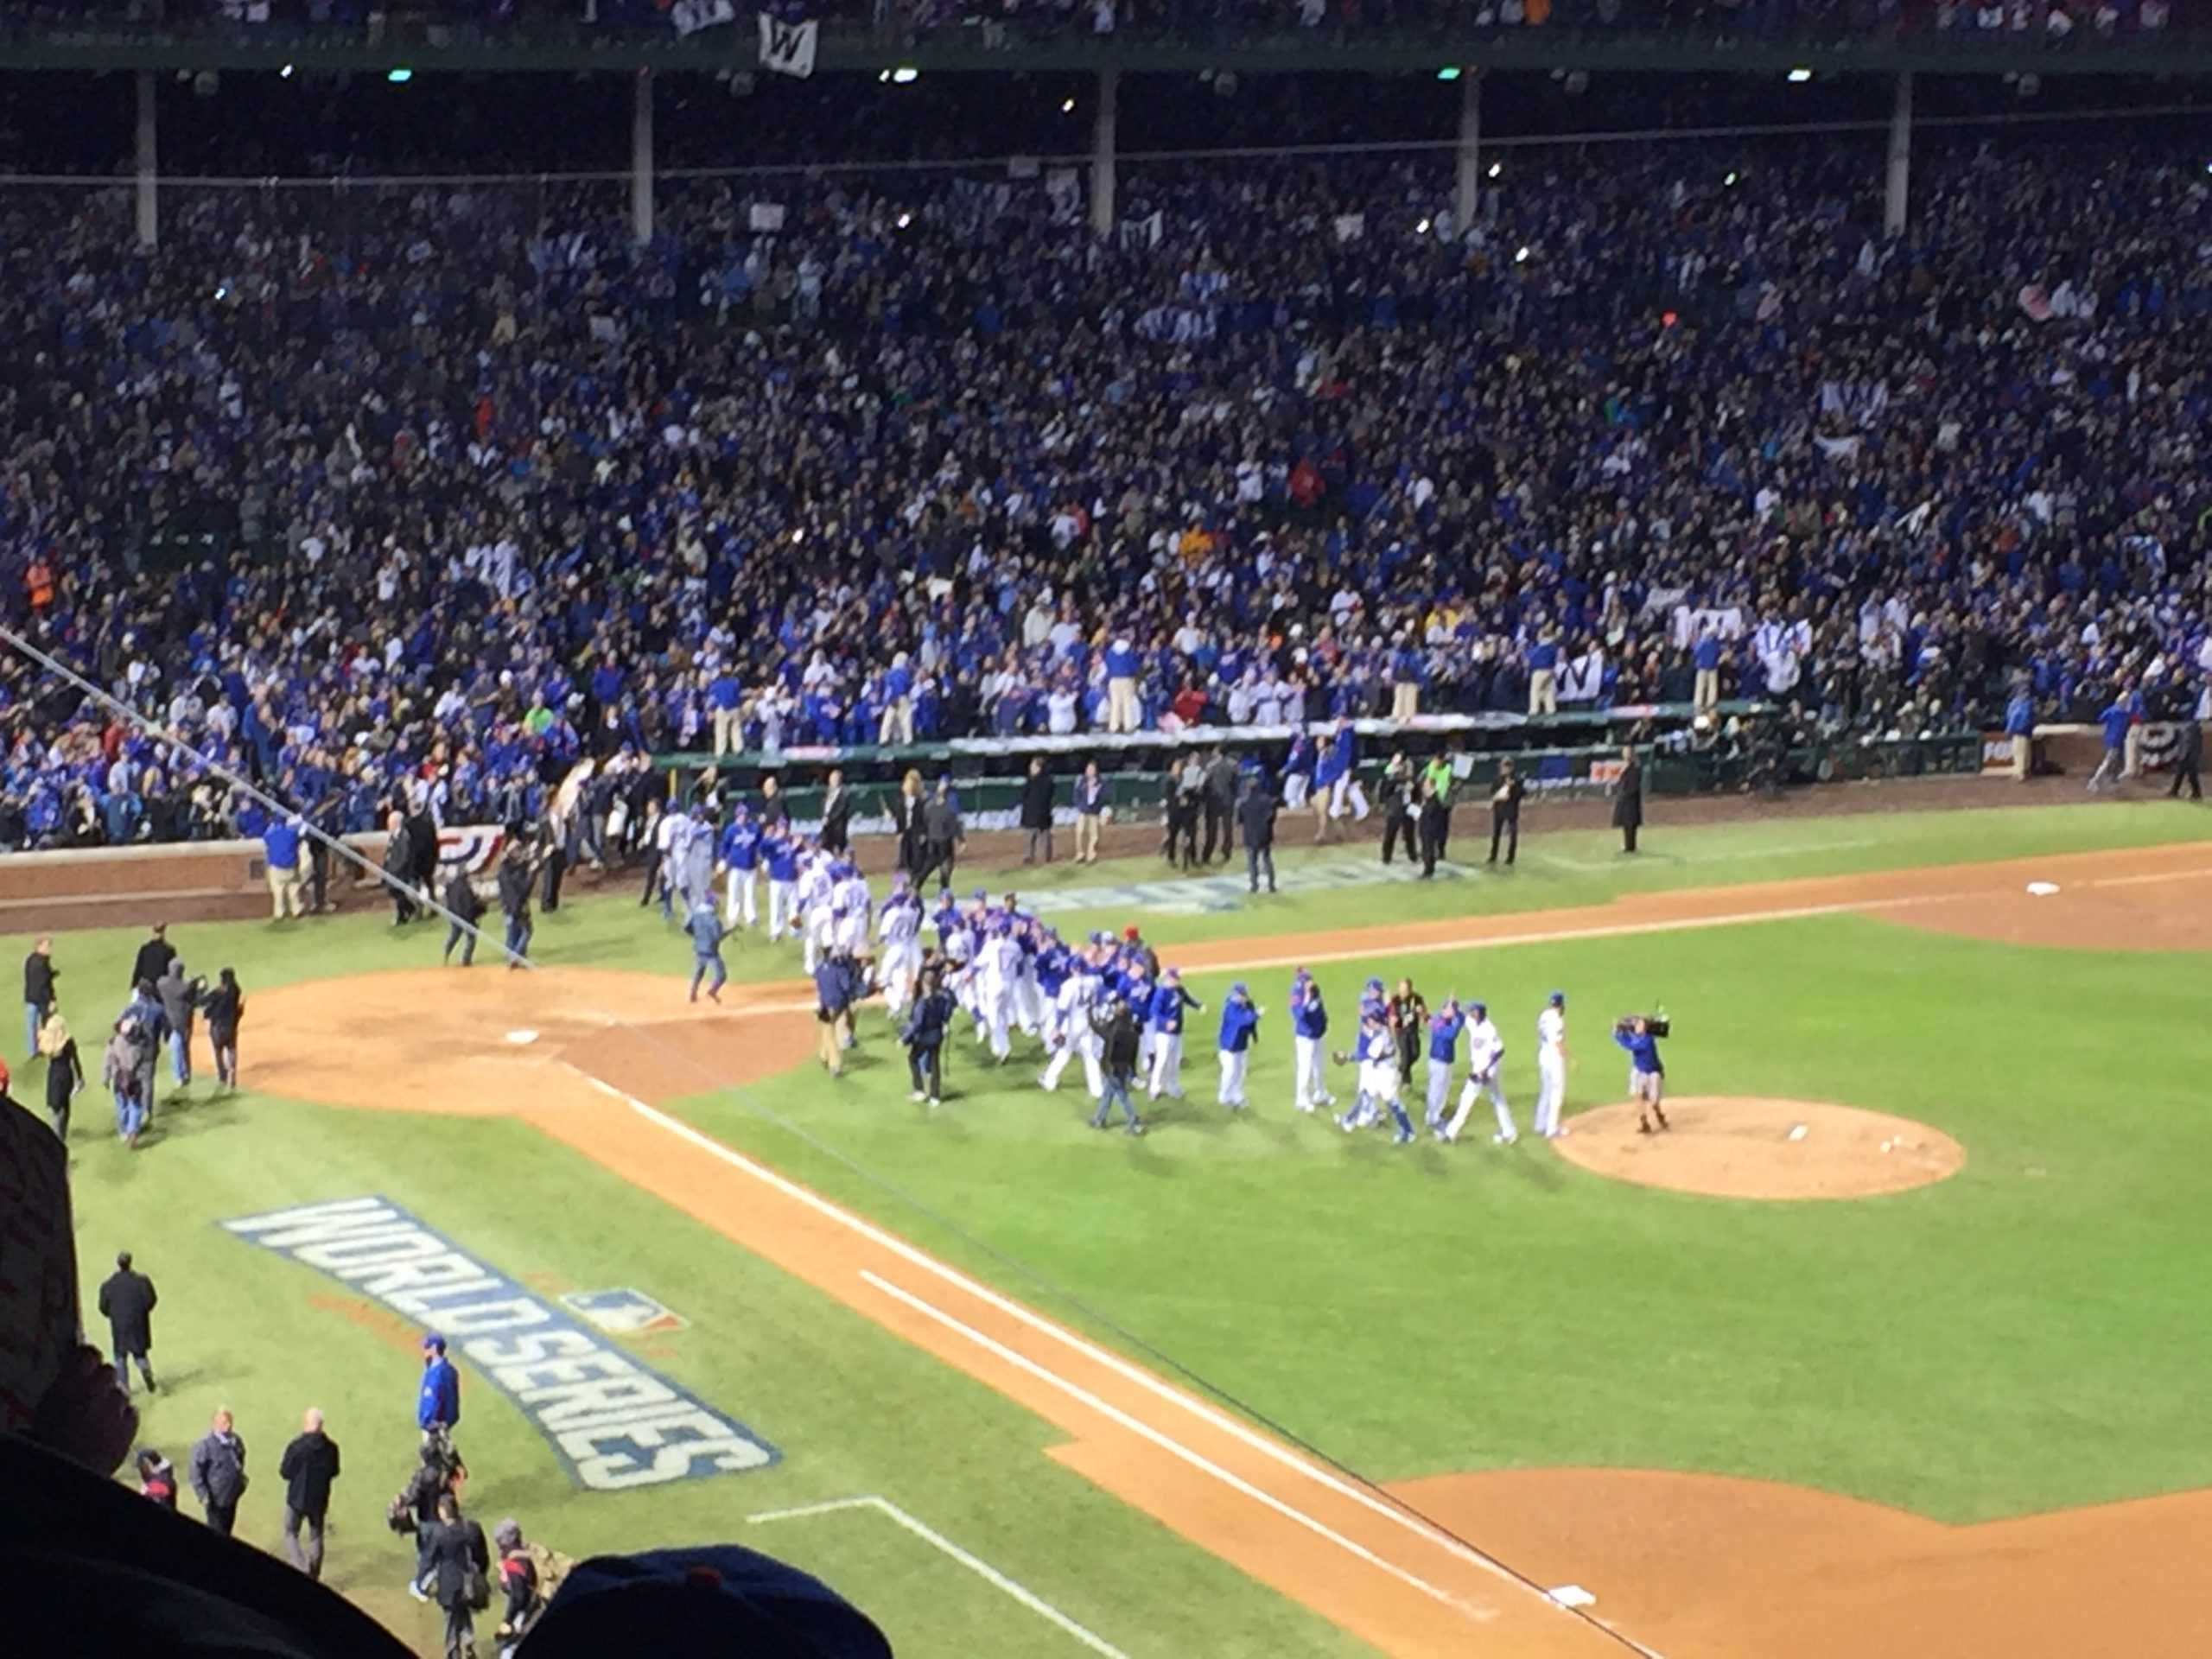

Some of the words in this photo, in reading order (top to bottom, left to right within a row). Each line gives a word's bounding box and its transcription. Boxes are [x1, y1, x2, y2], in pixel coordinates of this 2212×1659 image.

[771, 17, 806, 63] W
[221, 1198, 550, 1333] WORLD
[464, 1330, 771, 1491] SERIES
